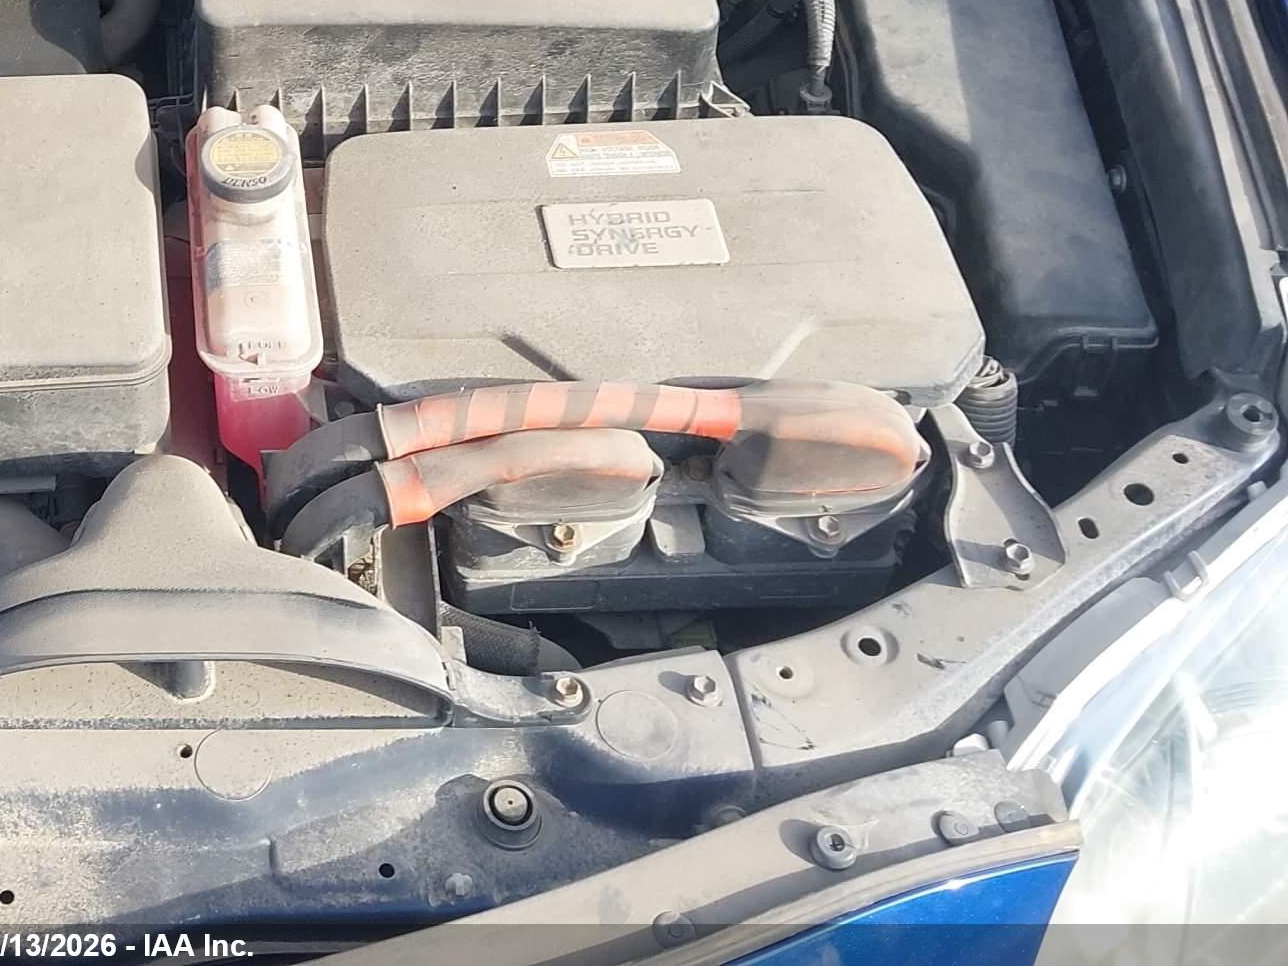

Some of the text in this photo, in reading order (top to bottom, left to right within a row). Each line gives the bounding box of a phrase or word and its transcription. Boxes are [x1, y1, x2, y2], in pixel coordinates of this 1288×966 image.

[221, 176, 268, 188] DENSO
[568, 210, 671, 226] HYBRID
[571, 225, 698, 242] SYNERGY
[576, 241, 659, 256] DRIVE
